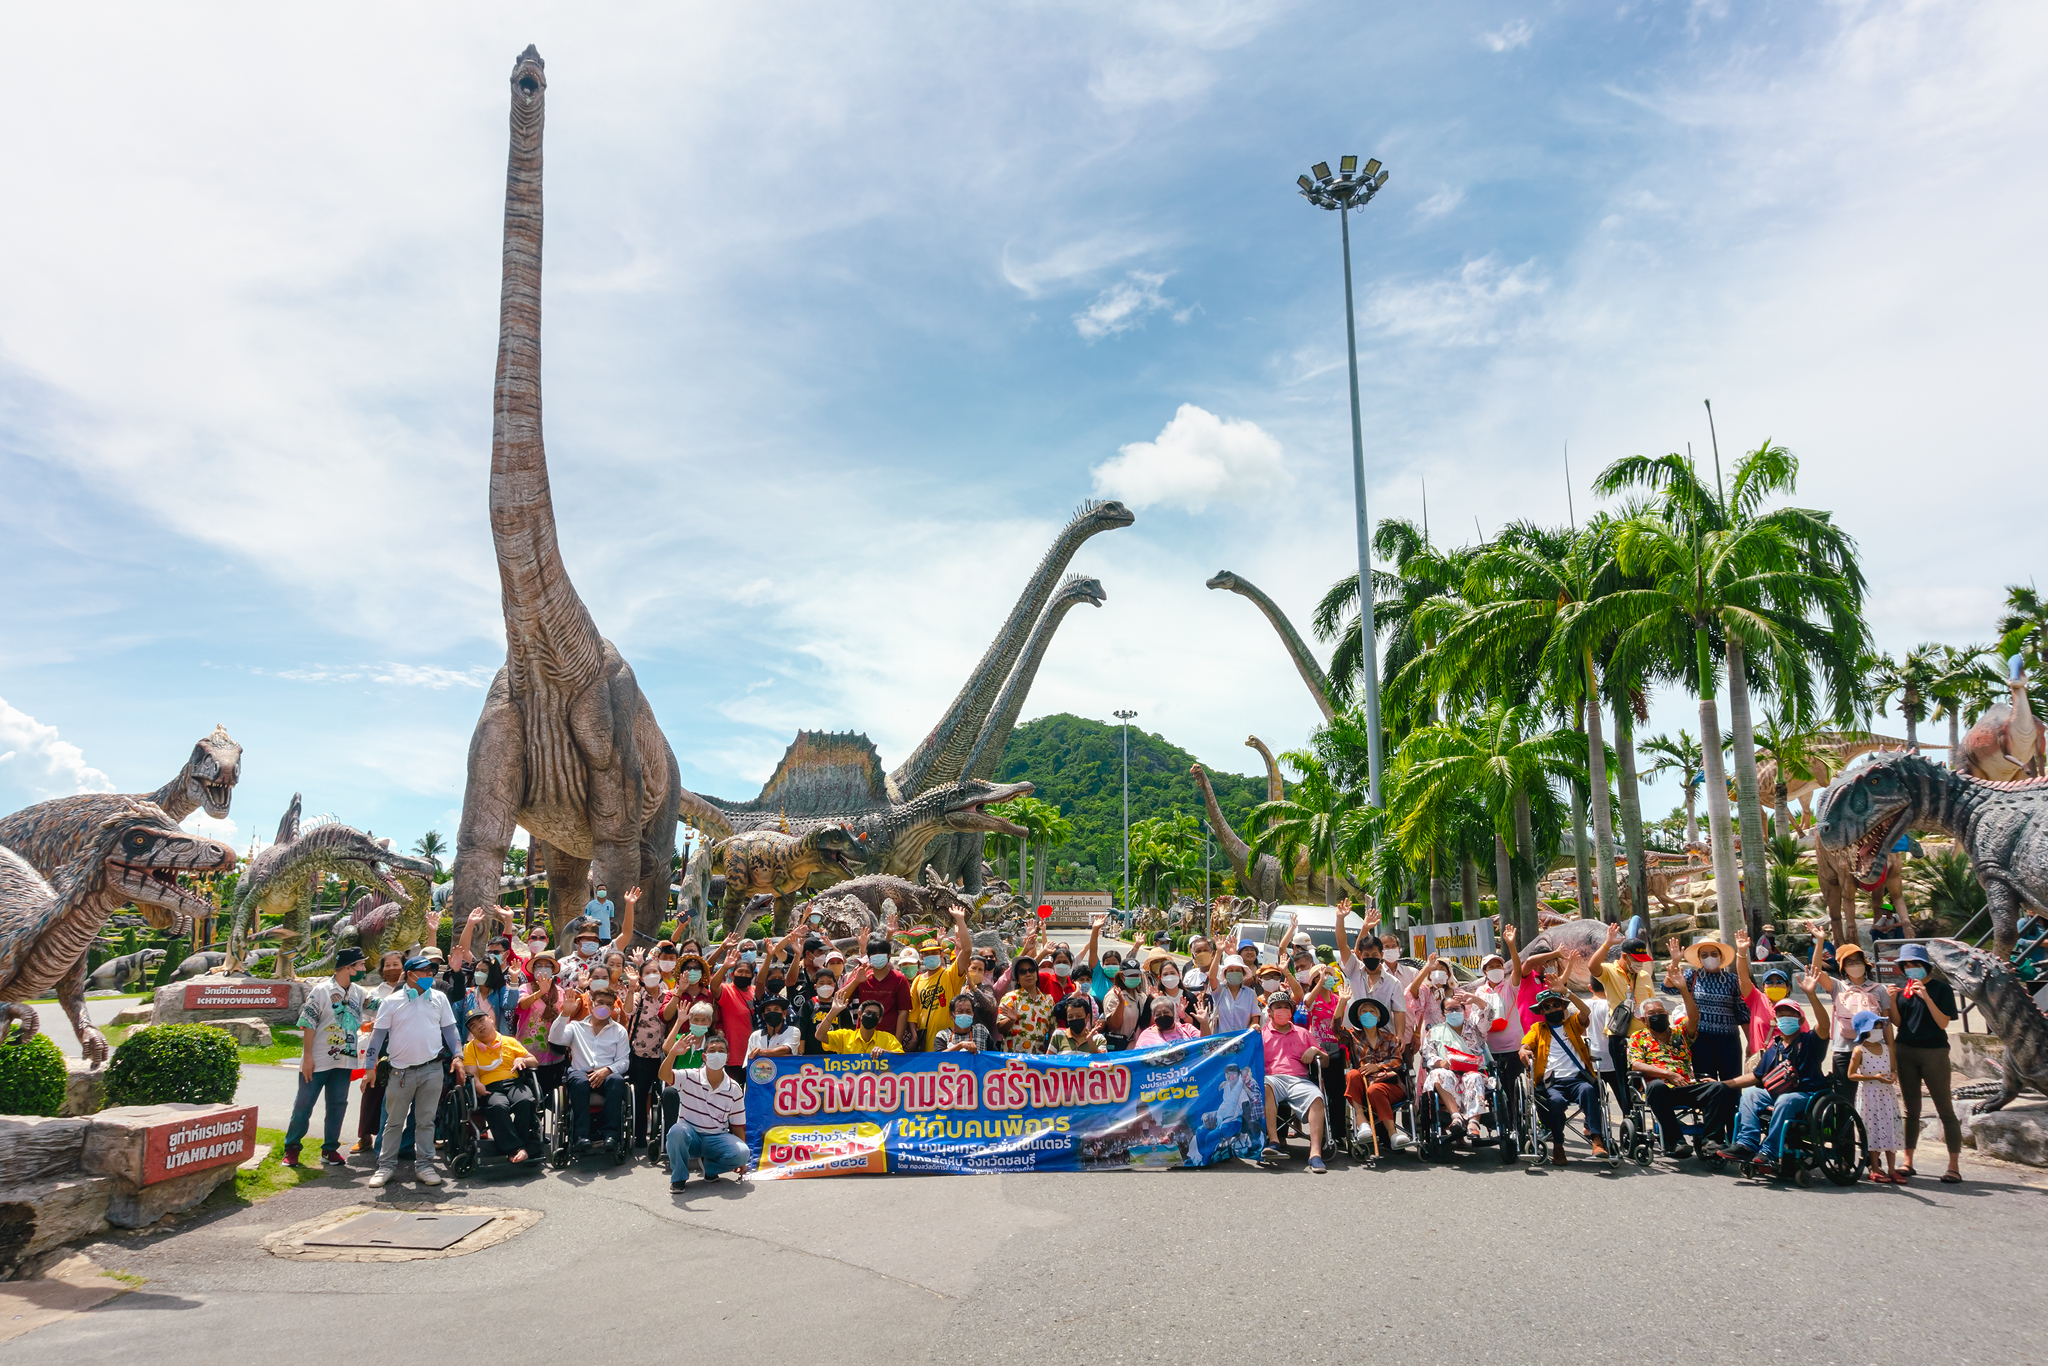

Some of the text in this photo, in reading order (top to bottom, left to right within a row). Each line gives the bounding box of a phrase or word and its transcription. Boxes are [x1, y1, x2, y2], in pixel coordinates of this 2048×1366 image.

[1461, 956, 1482, 969] VALLEY
[197, 997, 277, 1005] ICHTHYOVENATOR
[825, 1058, 889, 1072] โครงการ
[1146, 1066, 1189, 1082] ประจำปี
[775, 1060, 1130, 1114] สร้างความรัก สร้างพลัง
[1140, 1078, 1179, 1089] งบประมาณ
[1140, 1085, 1199, 1102] ๒๕๖๕
[169, 1115, 246, 1152] ยูท่าห์แรปเตอร์
[898, 1114, 1071, 1138] ให้กับคนพิการ
[898, 1142, 912, 1150] ณ
[166, 1139, 243, 1169] UTAHRAPTOR
[967, 1153, 1036, 1168] จังหวัดชลบุรี
[831, 1157, 867, 1168] ๒๕๖๕
